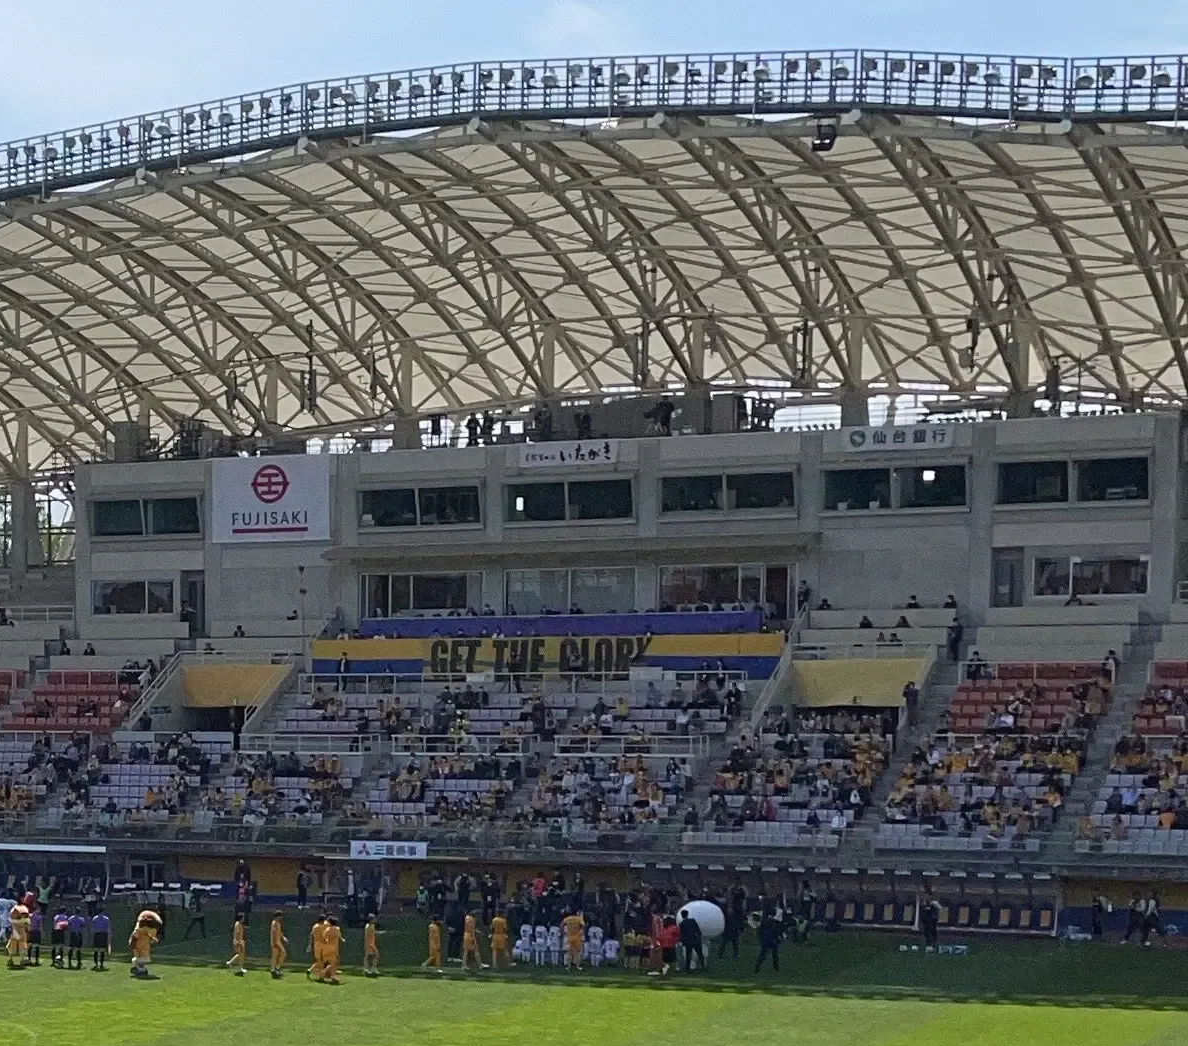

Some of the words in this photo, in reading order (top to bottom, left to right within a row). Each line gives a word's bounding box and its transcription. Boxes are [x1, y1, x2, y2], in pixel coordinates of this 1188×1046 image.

[231, 510, 309, 526] FUJISAKI
[430, 639, 482, 681] GET
[559, 636, 653, 681] GLORY
